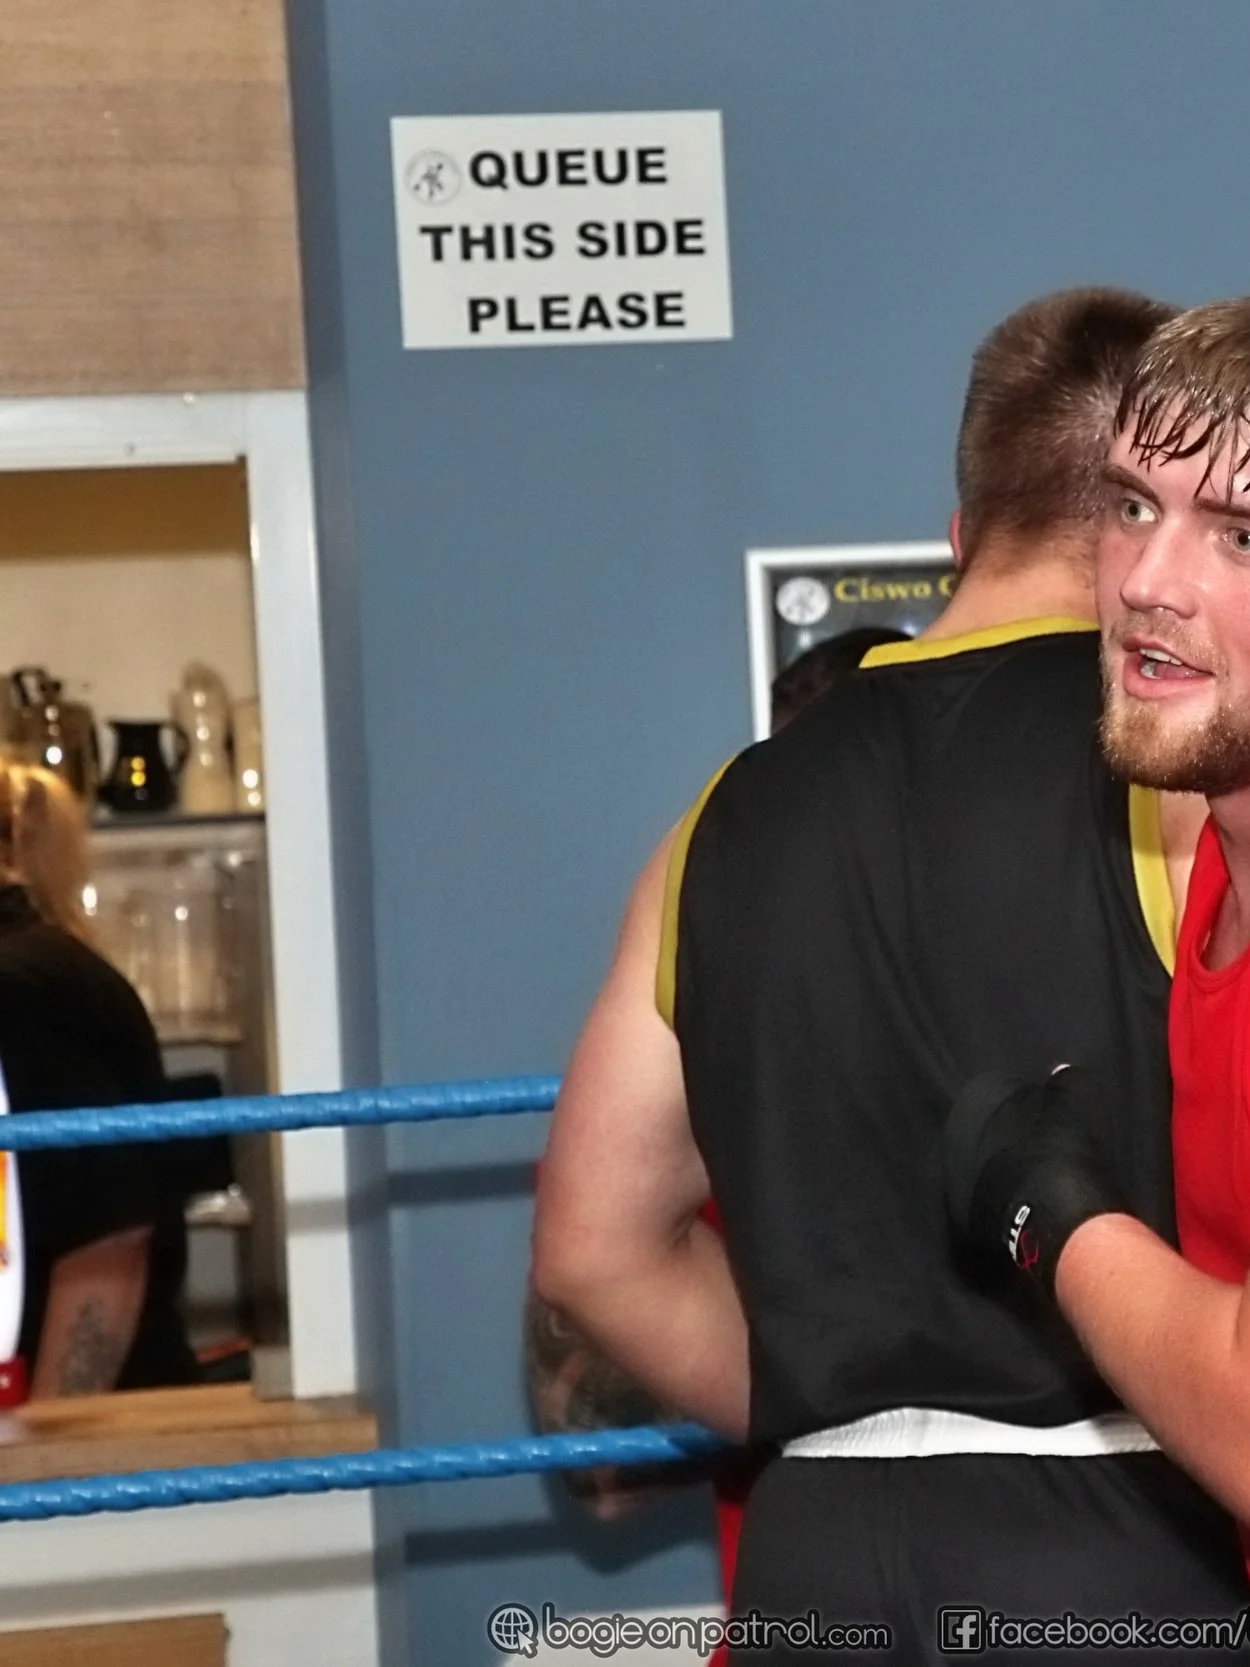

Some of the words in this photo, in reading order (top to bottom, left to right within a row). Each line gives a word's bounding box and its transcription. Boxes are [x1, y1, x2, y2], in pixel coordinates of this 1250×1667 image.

[468, 147, 668, 190] QUEUE
[419, 222, 555, 262] THIS
[576, 218, 706, 259] SIDE
[467, 292, 686, 334] PLEASE
